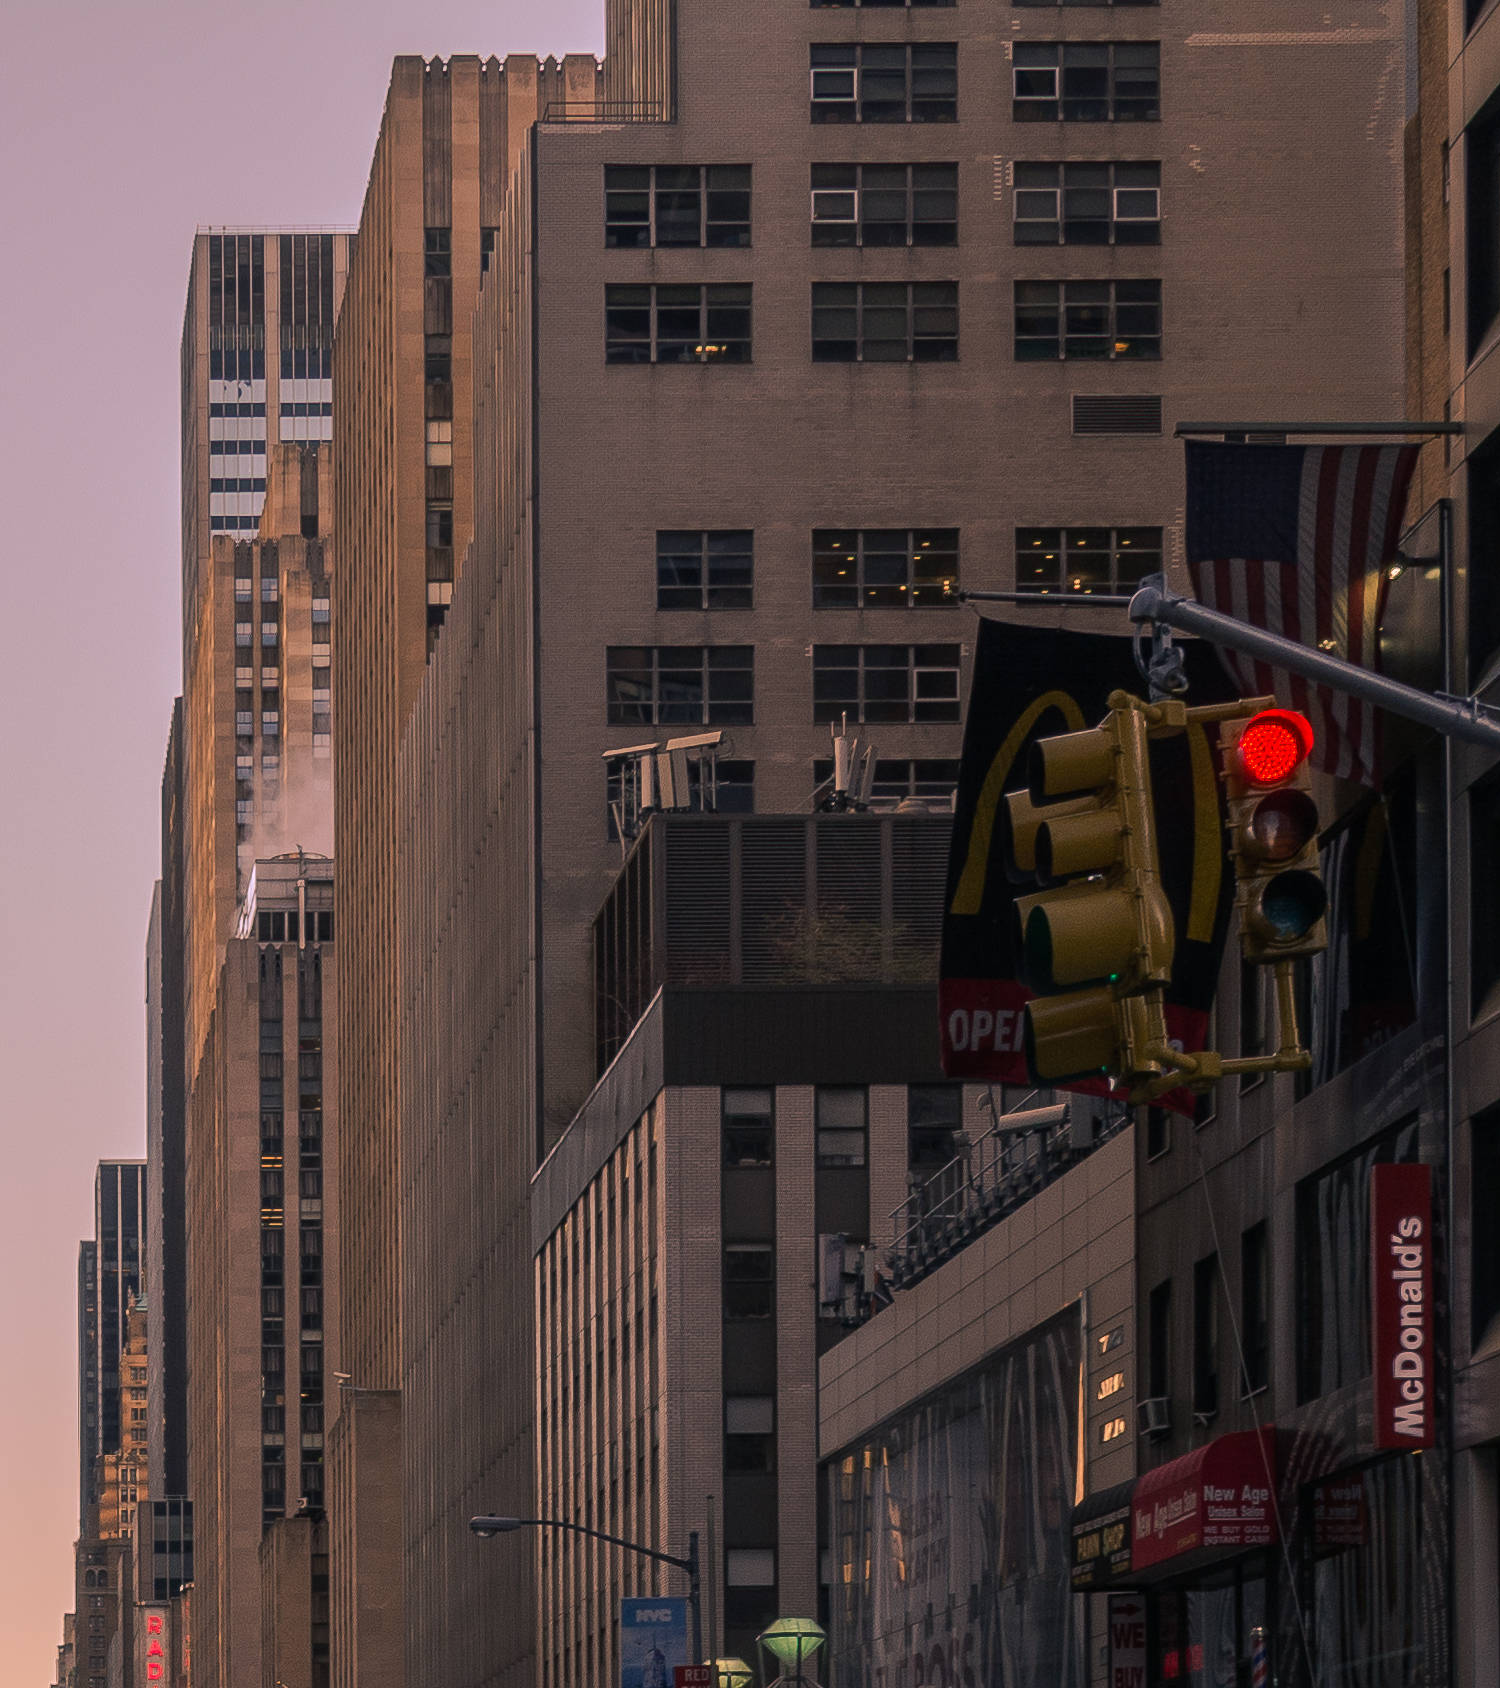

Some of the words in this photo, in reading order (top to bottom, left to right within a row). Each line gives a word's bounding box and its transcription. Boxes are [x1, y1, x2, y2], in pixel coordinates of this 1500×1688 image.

[1391, 1215, 1425, 1438] McDonald's
[1203, 1485, 1235, 1501] New
[1242, 1485, 1269, 1505] Age
[1204, 1526, 1218, 1534] WE
[1222, 1526, 1239, 1534] BUY
[1244, 1525, 1270, 1534] GOLD
[635, 1609, 672, 1622] NYC
[1112, 1623, 1144, 1649] WE
[684, 1668, 709, 1682] RED
